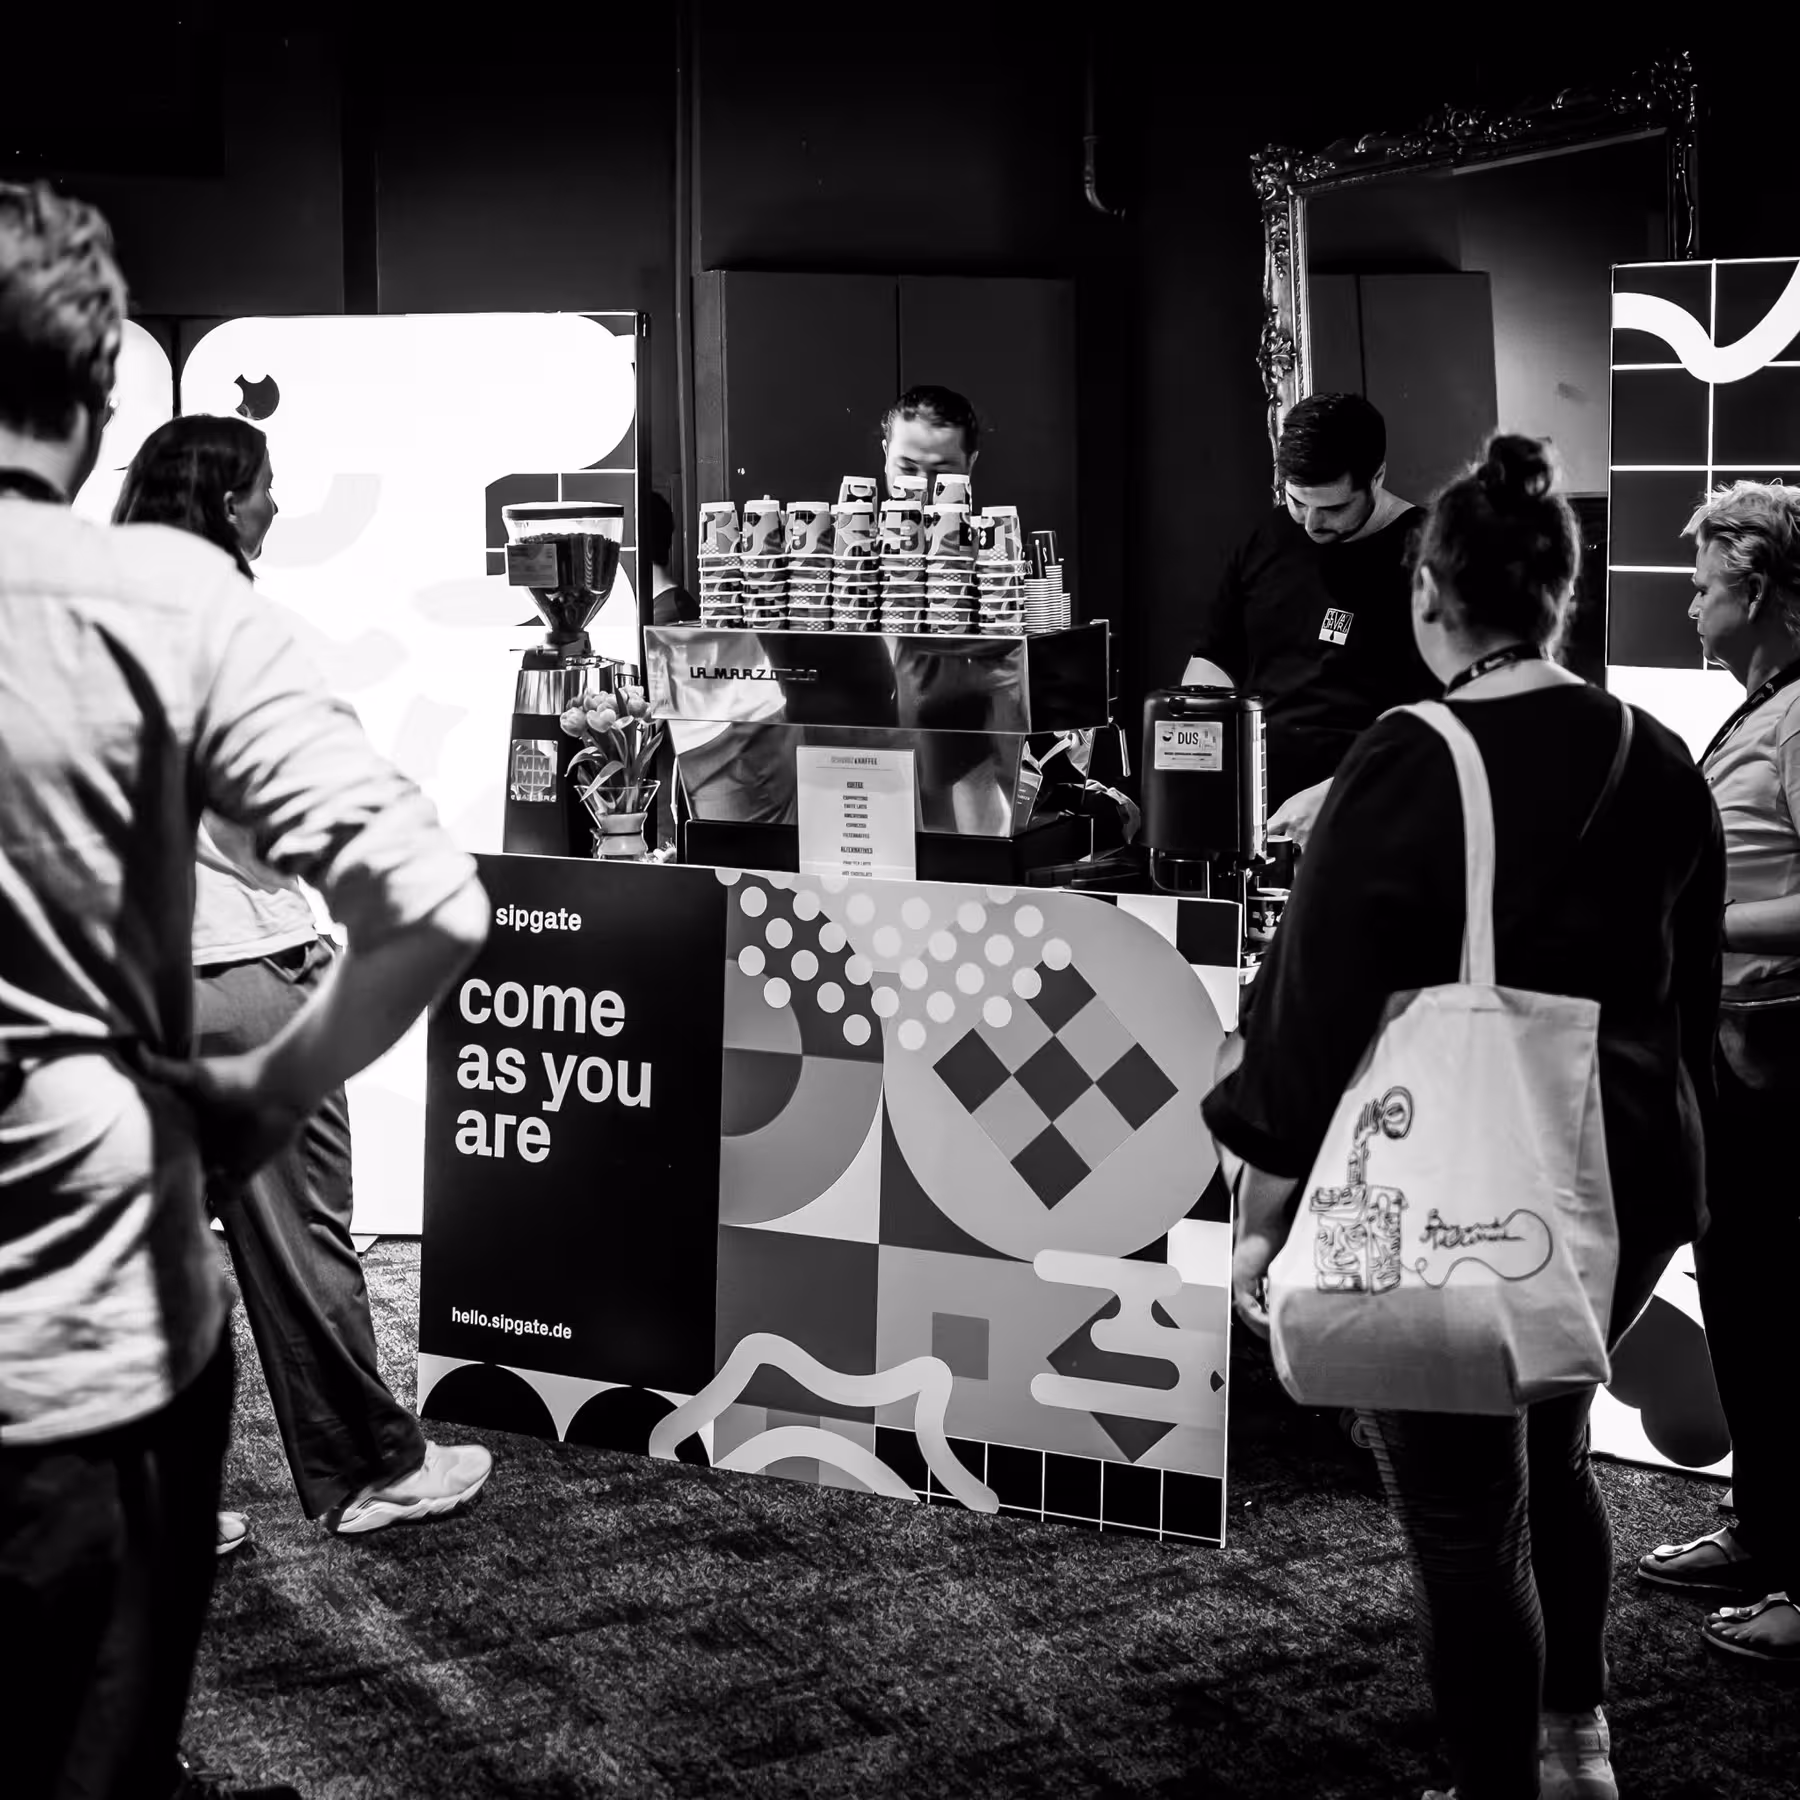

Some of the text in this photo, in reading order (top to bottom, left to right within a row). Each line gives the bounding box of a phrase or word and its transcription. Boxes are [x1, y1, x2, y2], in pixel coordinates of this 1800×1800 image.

[690, 667, 706, 678] LA
[1177, 731, 1199, 745] DUS
[495, 903, 582, 934] sipgate
[459, 978, 626, 1037] come
[456, 1043, 652, 1113] as you
[455, 1107, 551, 1163] are
[451, 1306, 572, 1340] hello.sipgate.de
